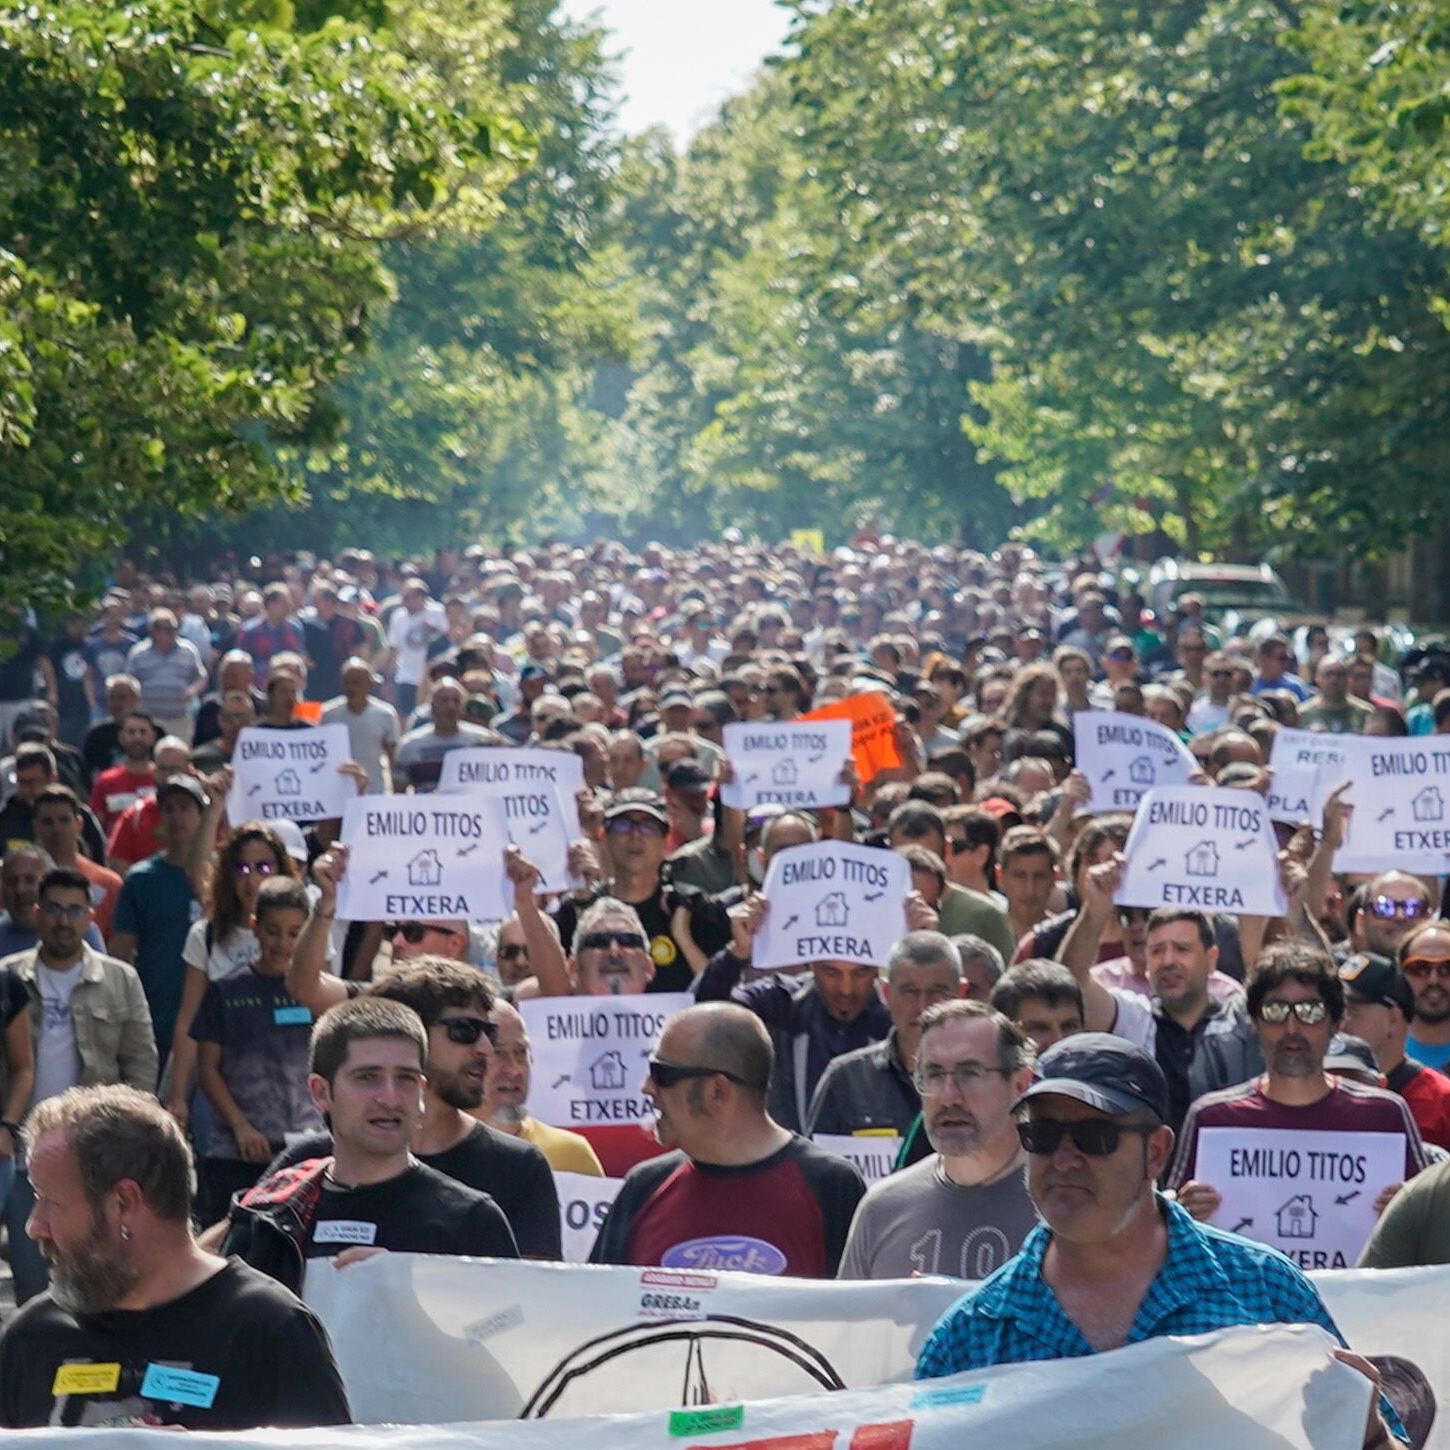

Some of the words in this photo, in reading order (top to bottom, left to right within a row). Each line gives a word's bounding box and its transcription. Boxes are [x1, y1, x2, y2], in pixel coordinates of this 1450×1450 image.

[742, 734, 788, 750] EMILIO
[792, 733, 827, 750] TITOS
[1097, 725, 1142, 746] EMILIO
[241, 741, 286, 760] EMILIO
[289, 740, 327, 760] TITOS
[458, 761, 509, 784] EMILIO
[1371, 753, 1428, 777] EMILIO
[261, 800, 326, 819] ETXERA
[504, 795, 550, 817] TITOS
[1148, 801, 1208, 827] EMILIO
[1213, 804, 1262, 833] TITOS
[366, 812, 427, 837] EMILIO
[431, 813, 483, 838] TITOS
[782, 857, 836, 886] EMILIO
[841, 858, 889, 888] TITOS
[386, 895, 470, 915] ETXERA
[1162, 883, 1245, 907] ETXERA
[796, 937, 873, 960] ETXERA
[547, 1013, 607, 1040] EMILIO
[614, 1013, 665, 1037] TITOS
[570, 1099, 653, 1120] ETXERA
[1231, 1147, 1301, 1179] EMILIO
[1307, 1150, 1367, 1184] TITOS
